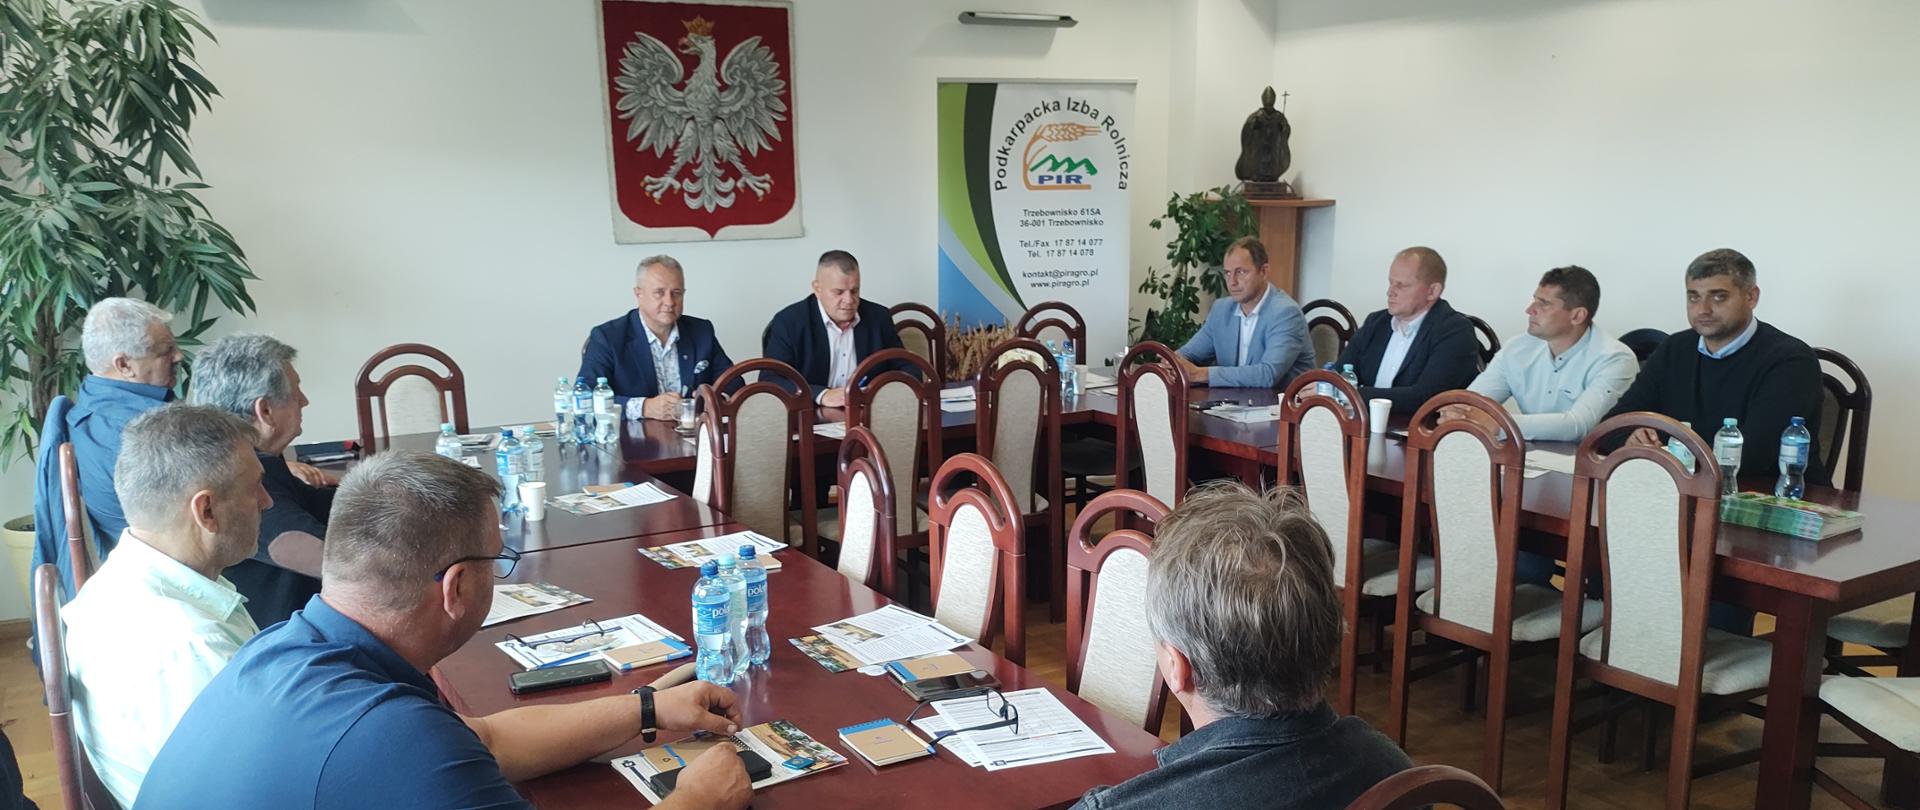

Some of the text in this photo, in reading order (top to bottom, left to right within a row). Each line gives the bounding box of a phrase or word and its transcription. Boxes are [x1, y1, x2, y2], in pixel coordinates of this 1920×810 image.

[994, 97, 1130, 191] Podkarpacka Izba Rolnicza
[1038, 174, 1083, 184] PIR
[1023, 207, 1101, 217] Trzebownisko 615A
[1020, 218, 1104, 228] 36-001 Trzebownisko
[1054, 239, 1063, 247] 17
[1065, 239, 1075, 247] 87
[1077, 238, 1086, 246] 14
[1088, 238, 1103, 246] 077
[1027, 250, 1041, 258] Tel.
[1046, 249, 1055, 257] 17
[1057, 249, 1066, 257] 87
[1069, 249, 1078, 257] 14
[1022, 268, 1099, 279] kontakt@piragro.pl
[1030, 279, 1090, 288] www.piragro.pl
